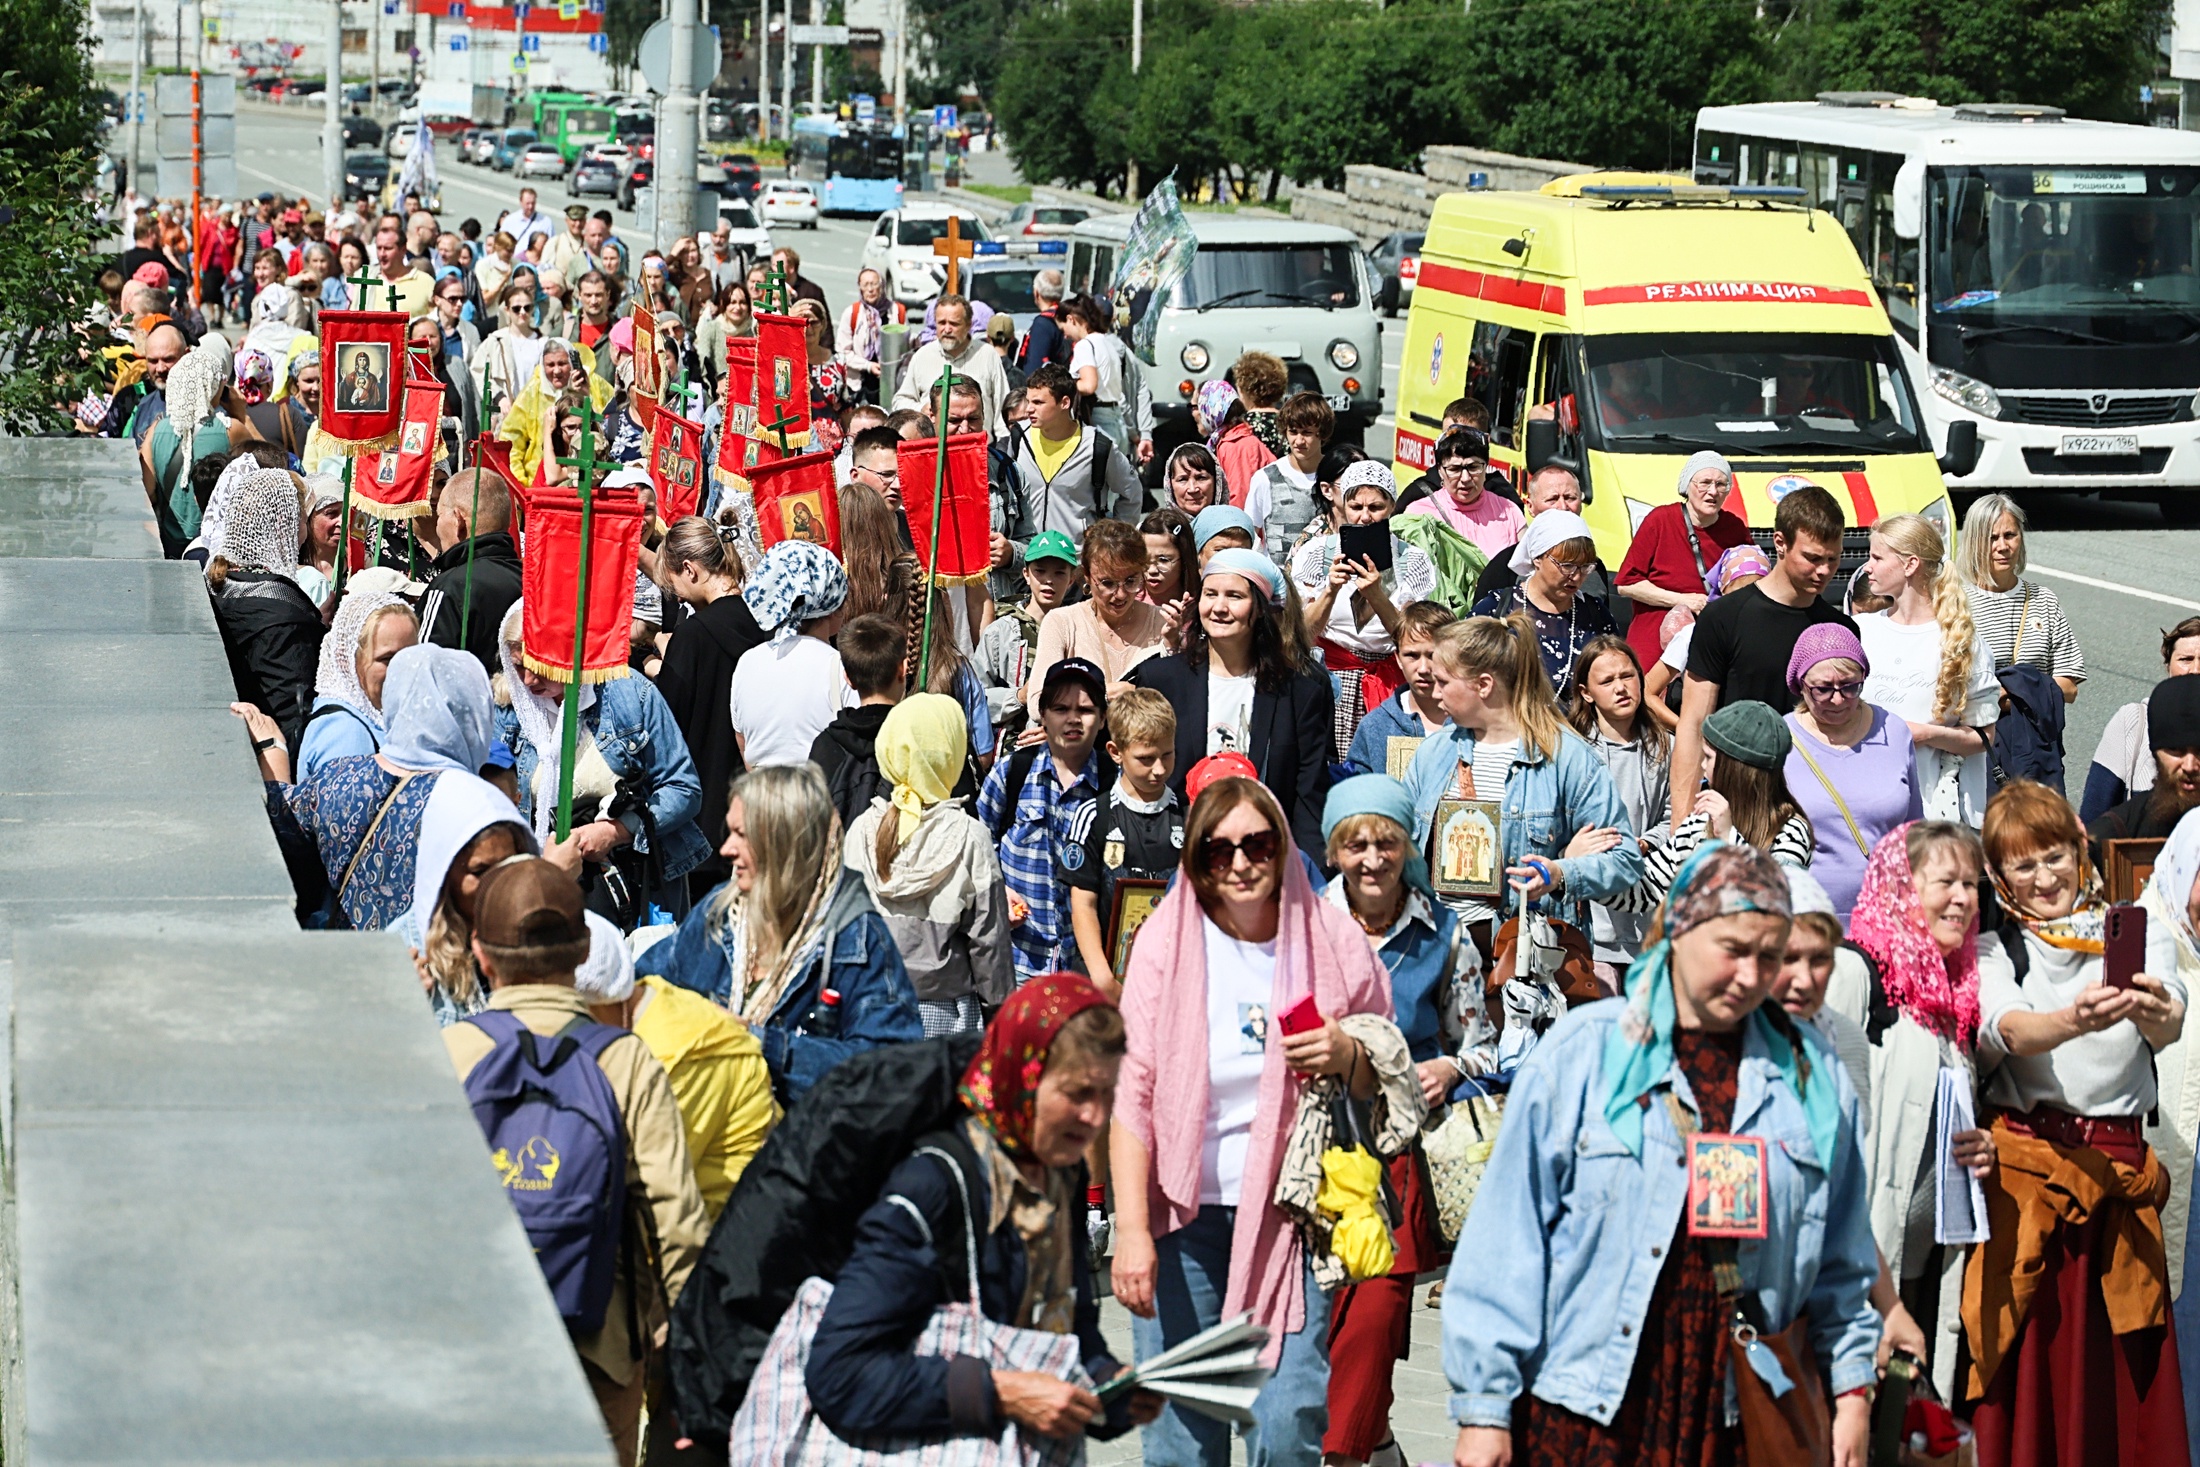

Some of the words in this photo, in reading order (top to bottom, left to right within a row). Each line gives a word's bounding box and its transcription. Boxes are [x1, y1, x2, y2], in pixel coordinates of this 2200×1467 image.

[1645, 282, 1817, 300] РЕАНИМАЦИЯ
[1399, 436, 1422, 465] СКОРАЯ
[1874, 684, 1907, 704] Club
